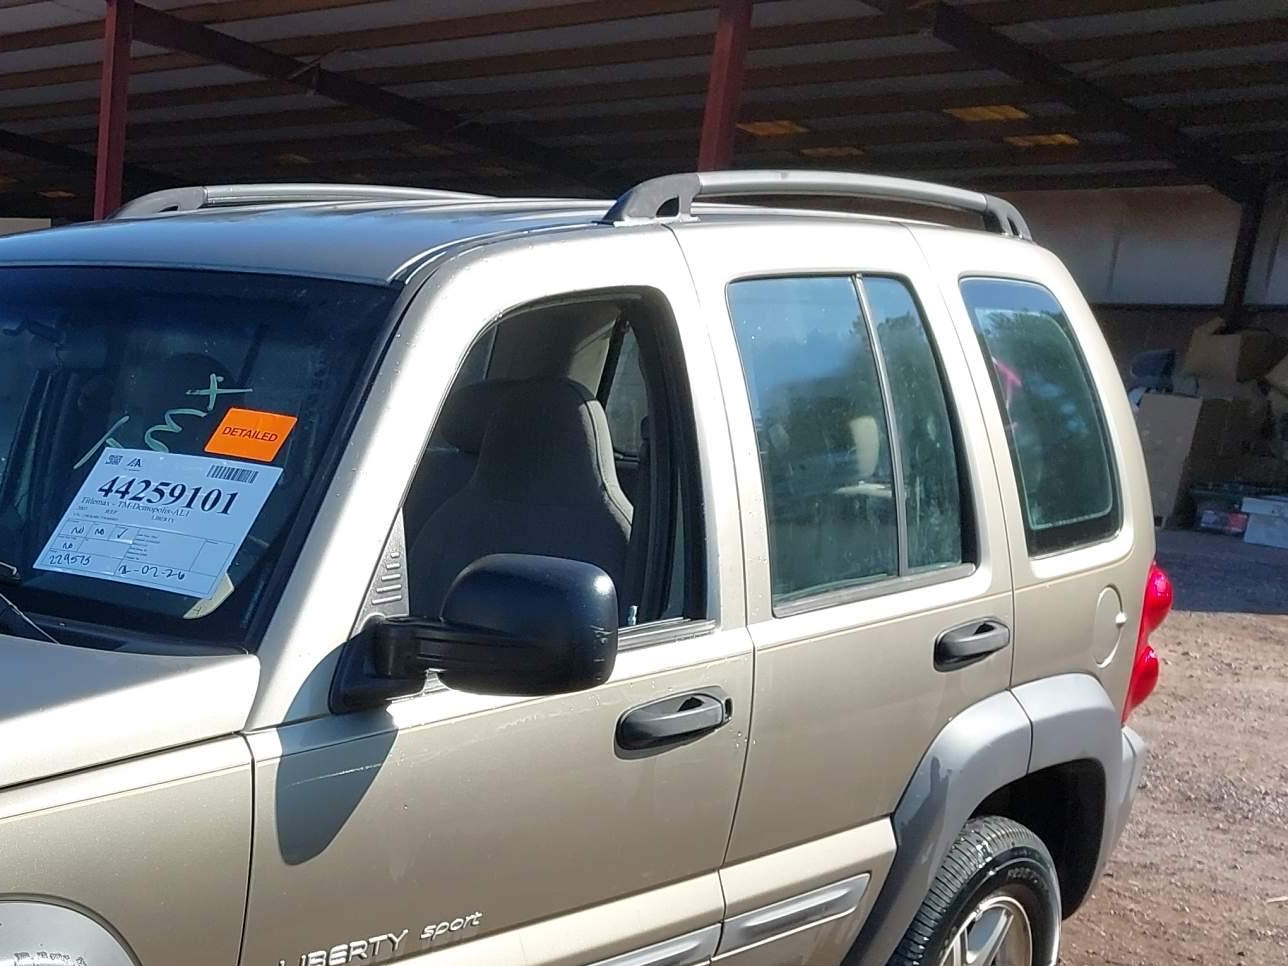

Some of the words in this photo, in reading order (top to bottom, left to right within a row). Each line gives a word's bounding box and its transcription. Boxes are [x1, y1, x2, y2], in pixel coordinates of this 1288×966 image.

[222, 426, 279, 443] DETAILED
[98, 475, 239, 516] 44259101
[420, 911, 482, 941] sport
